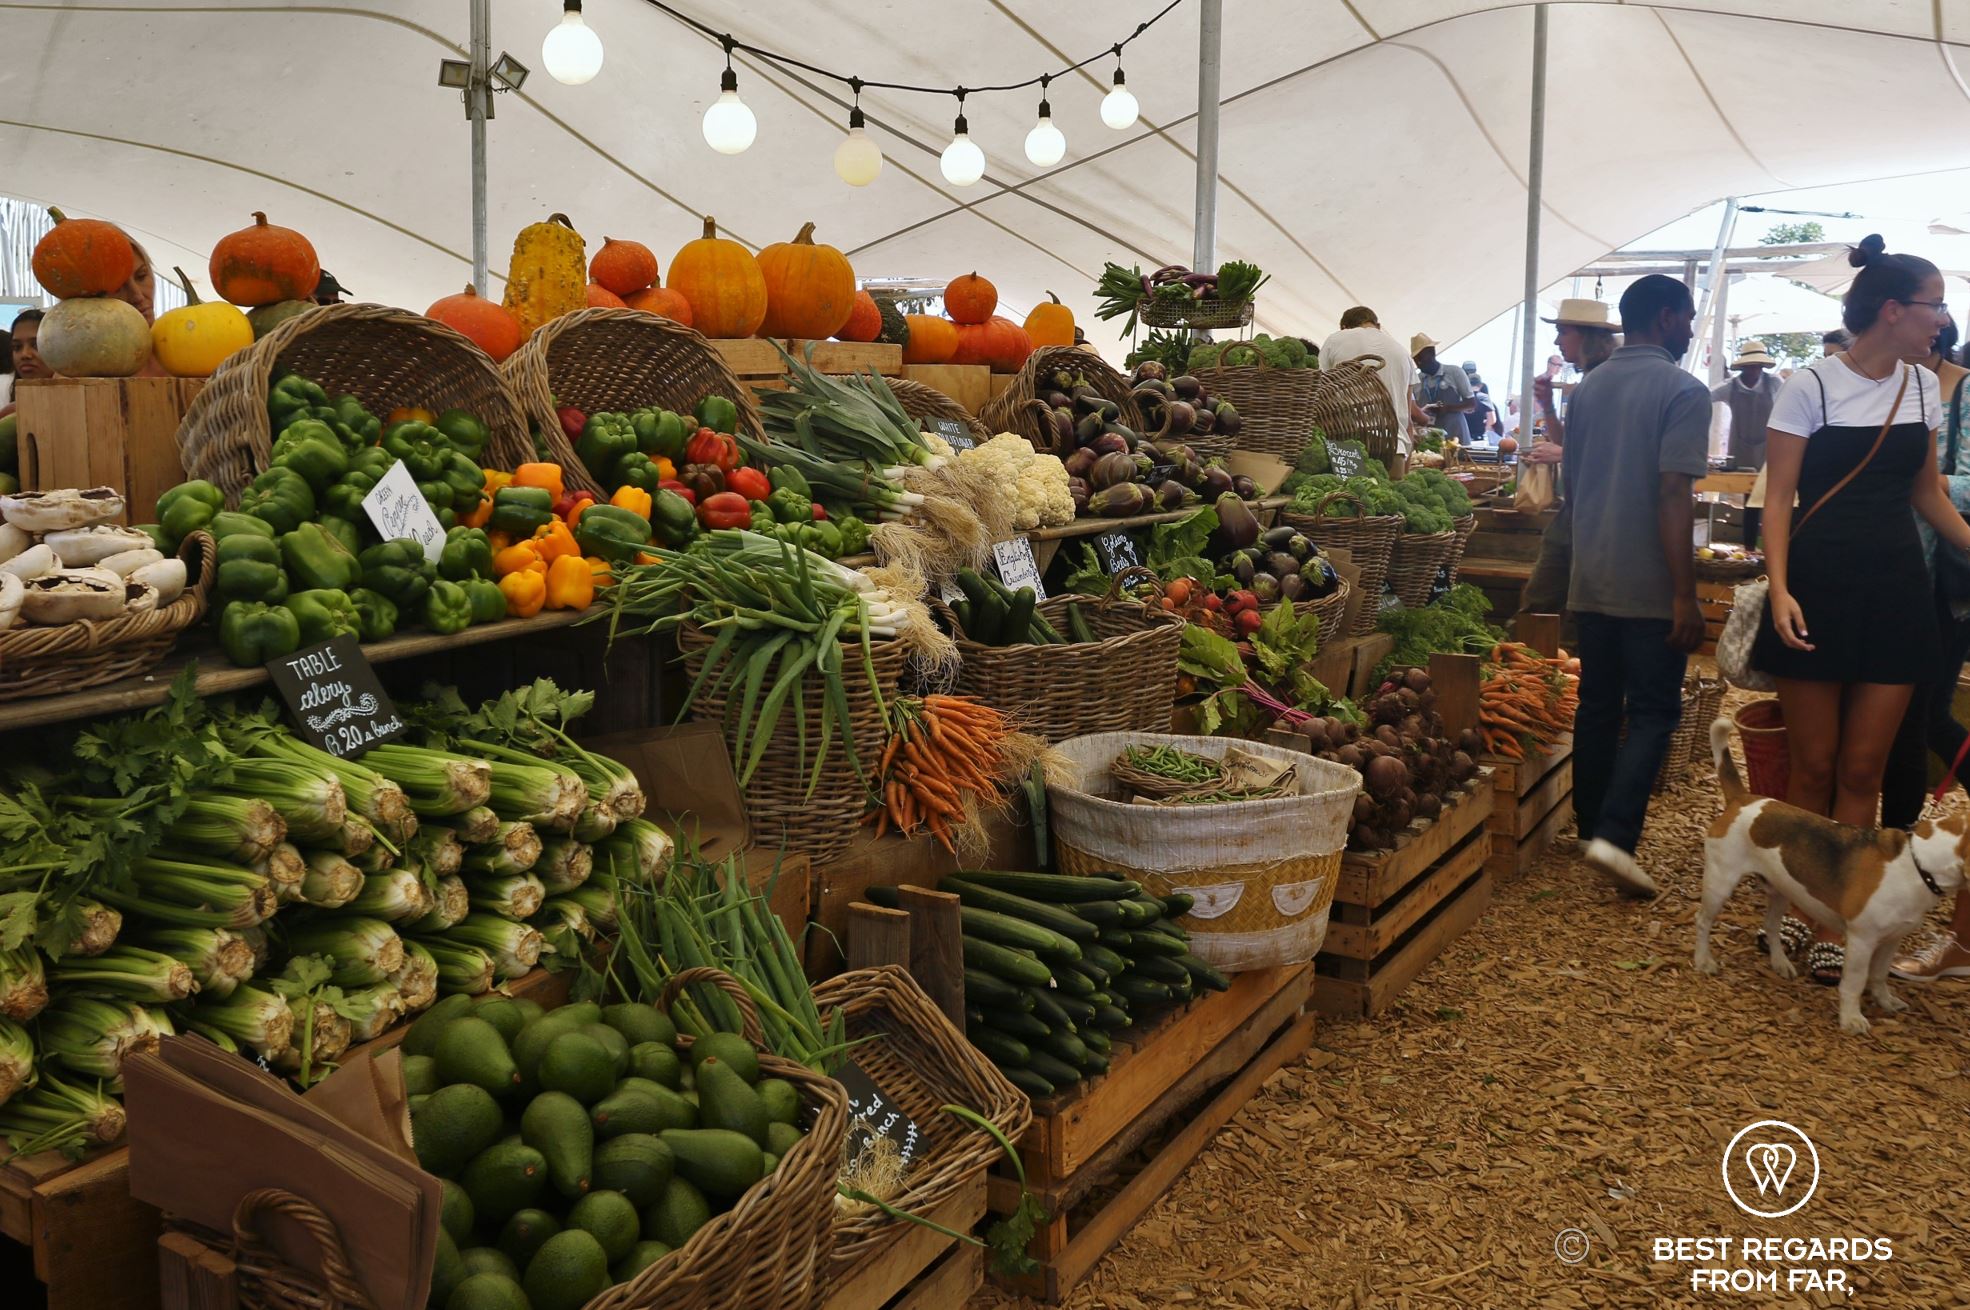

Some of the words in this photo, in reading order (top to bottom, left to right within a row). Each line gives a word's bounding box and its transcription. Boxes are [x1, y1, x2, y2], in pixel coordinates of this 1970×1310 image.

[937, 421, 961, 434] WHITE
[996, 543, 1027, 571] English
[286, 646, 342, 681] TABLE
[299, 681, 352, 711] celery
[338, 725, 363, 752] 20
[370, 715, 403, 738] bunch
